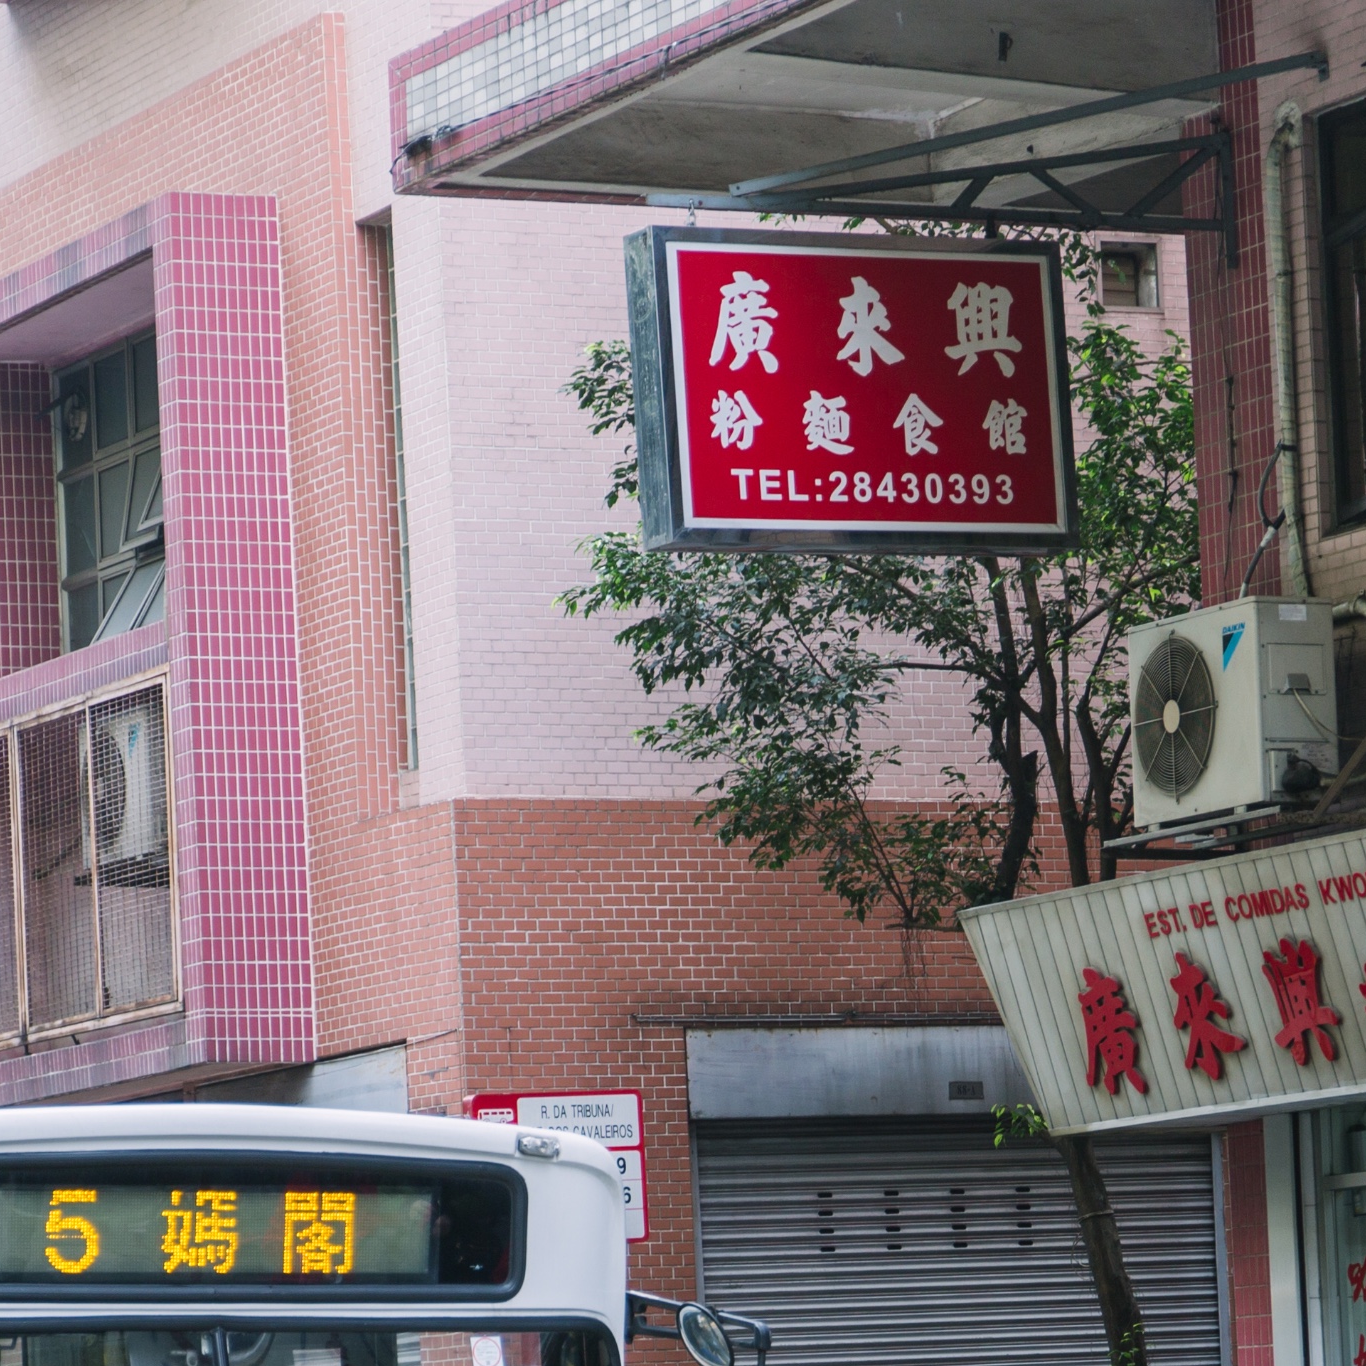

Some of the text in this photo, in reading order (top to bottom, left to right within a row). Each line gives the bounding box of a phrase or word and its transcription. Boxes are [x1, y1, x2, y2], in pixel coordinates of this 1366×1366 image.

[708, 270, 1023, 377] 廣來興
[710, 389, 1028, 456] 粉麵食館
[731, 468, 1015, 505] TEL:28430393
[1221, 622, 1246, 633] DAIKIN
[1144, 909, 1188, 940] EST.
[1190, 900, 1217, 930] DE
[1224, 881, 1311, 924] COMIDAS
[540, 1105, 551, 1120] R.
[553, 1104, 567, 1119] DA
[45, 1188, 357, 1275] 5 媽閣
